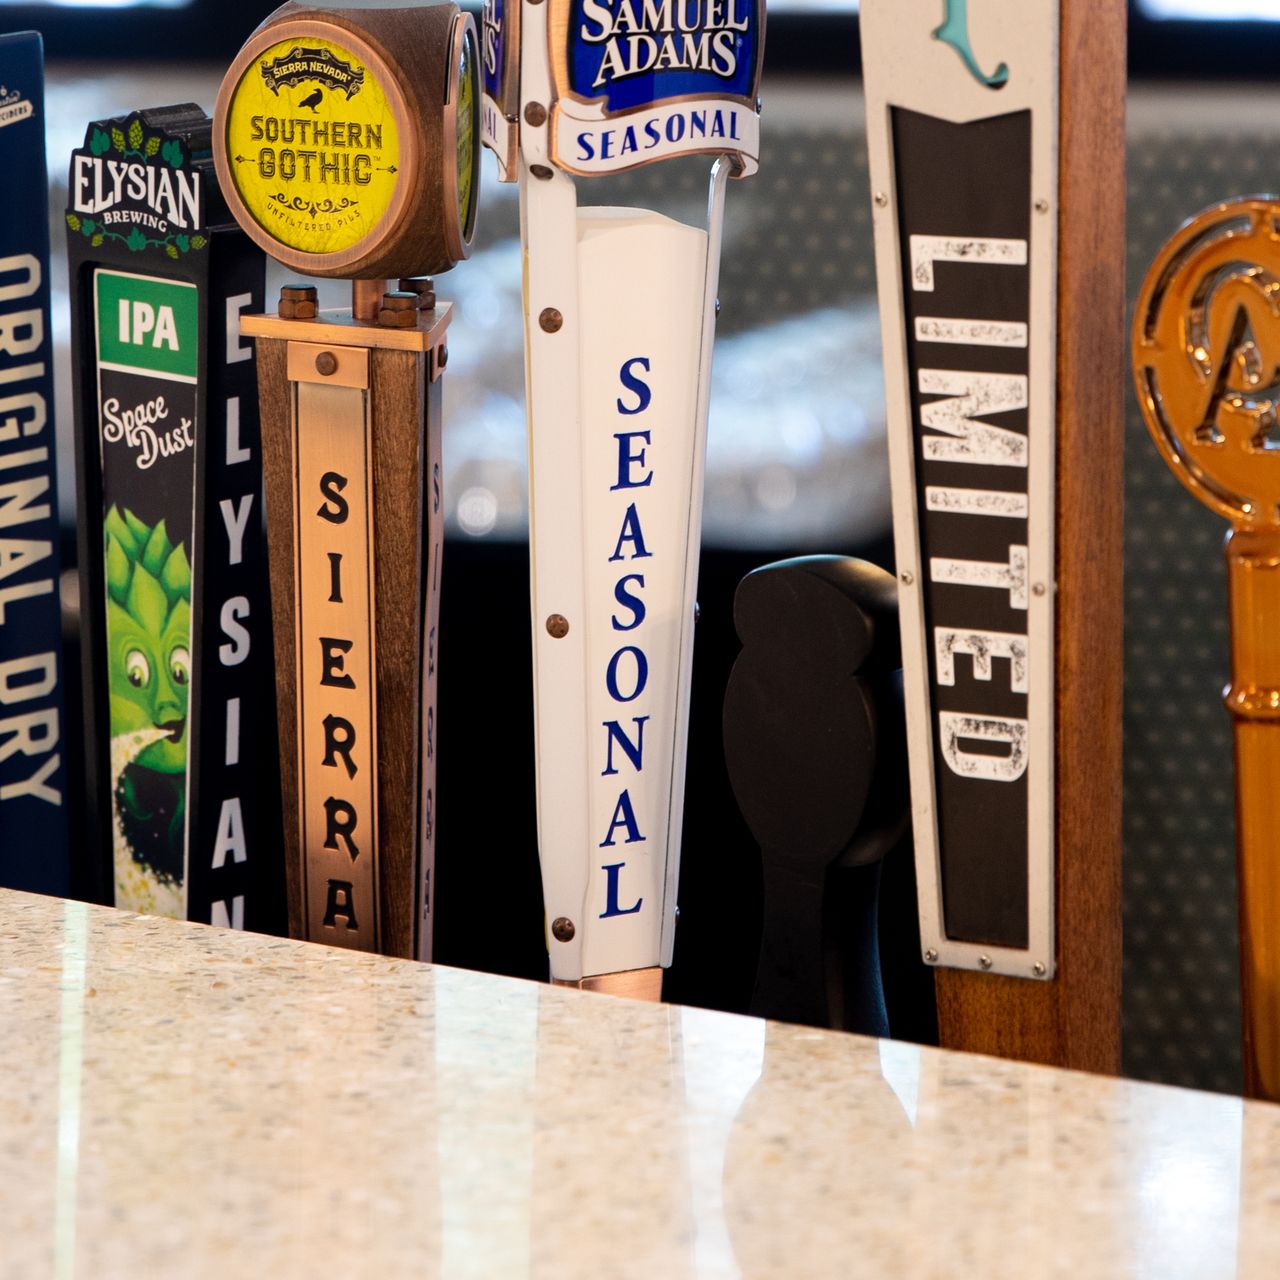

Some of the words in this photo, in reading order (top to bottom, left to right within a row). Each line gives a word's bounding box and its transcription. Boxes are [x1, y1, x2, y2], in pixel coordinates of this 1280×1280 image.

[273, 61, 308, 79] SIERRA
[309, 62, 349, 81] NEVADA
[591, 31, 738, 88] ADAMS
[251, 115, 383, 150] SOUTHERN
[576, 109, 742, 162] SEASONAL
[74, 154, 200, 231] ELYSIAN
[258, 147, 373, 186] GOTHIC
[102, 209, 168, 232] BREWING
[267, 202, 332, 232] UNFILTERED
[118, 298, 180, 352] IPA
[103, 395, 169, 448] Space
[131, 417, 194, 470] Dust
[909, 234, 1028, 783] LIMITED
[598, 356, 655, 920] SEASONAL
[316, 471, 360, 931] SIERRA
